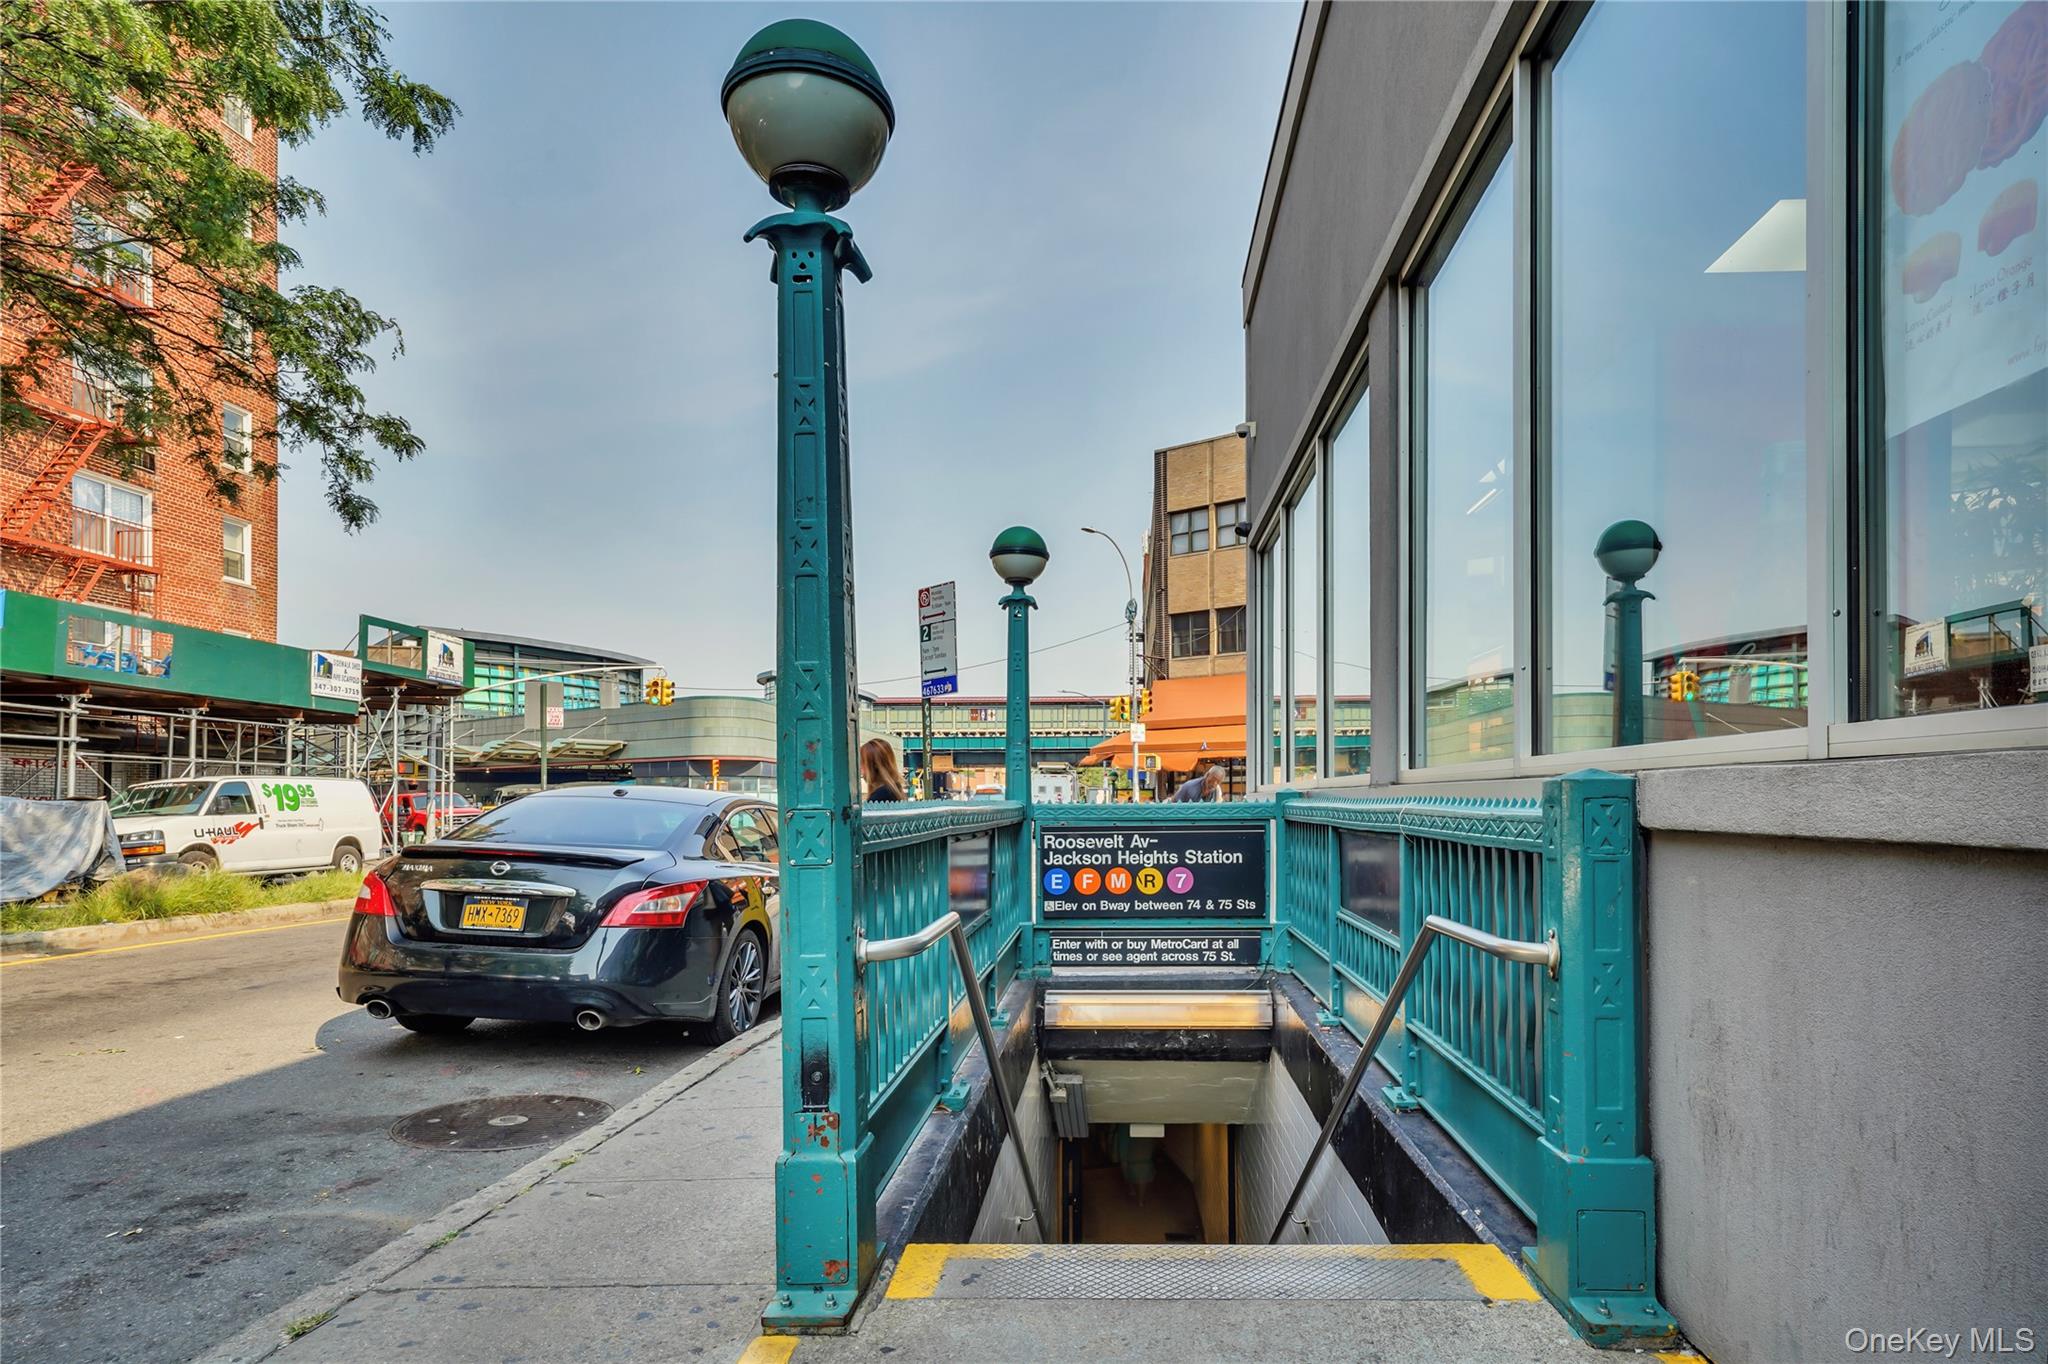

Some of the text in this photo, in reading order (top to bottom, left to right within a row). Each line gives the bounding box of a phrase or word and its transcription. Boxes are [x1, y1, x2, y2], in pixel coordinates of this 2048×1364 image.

[922, 626, 929, 641] 2
[194, 826, 239, 838] U-HAUL
[1044, 834, 1124, 849] Roosevelt
[1044, 849, 1243, 867] Jackson Heights Station
[402, 863, 433, 872] MAXIMA
[1051, 873, 1187, 889] E F M R 7
[1055, 899, 1256, 912] Elev on Bway between 74 & 75 Sts
[467, 906, 520, 923] HMX 7369
[1052, 939, 1239, 951] Enter with or buy MetroCard at all
[1053, 951, 1236, 963] times or see agent across 75 St.
